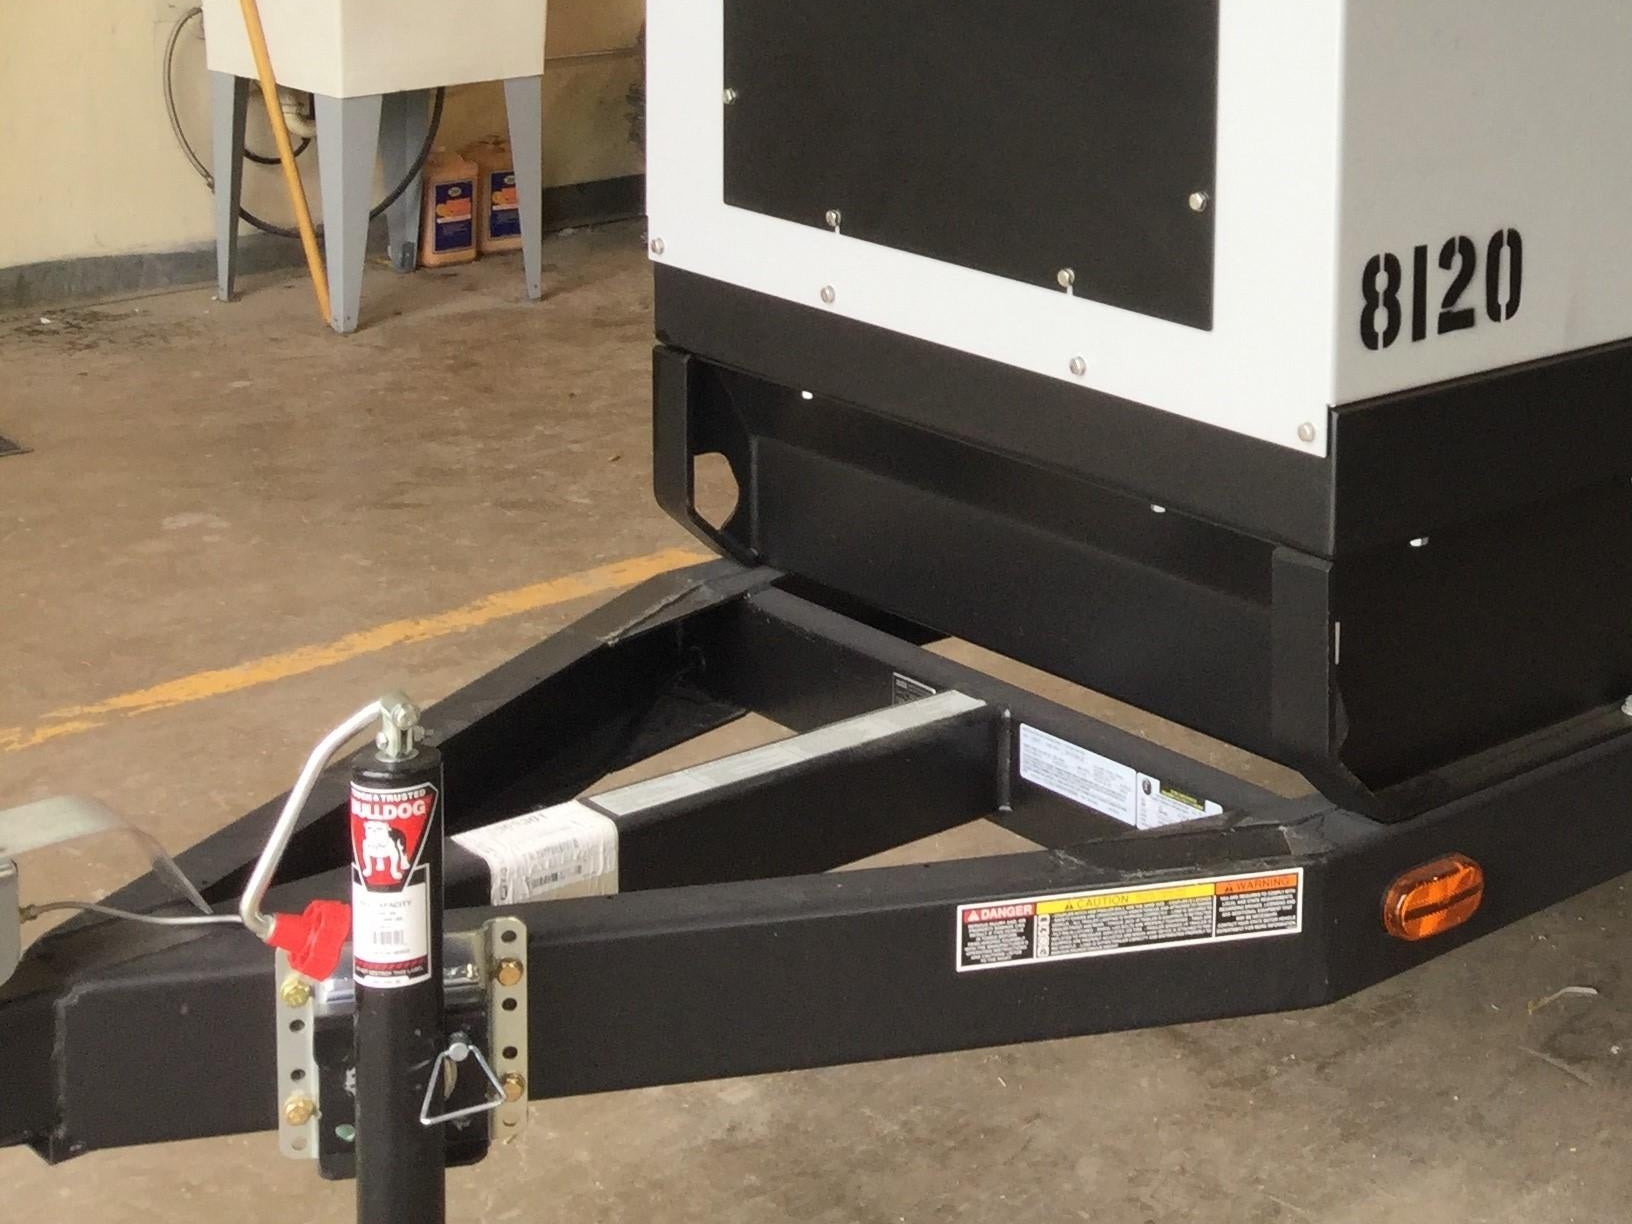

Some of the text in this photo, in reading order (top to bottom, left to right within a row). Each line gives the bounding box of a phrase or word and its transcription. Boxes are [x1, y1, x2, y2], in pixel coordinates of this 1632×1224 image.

[1360, 227, 1523, 351] 8120
[1237, 877, 1290, 890] WARNING
[1077, 895, 1129, 908] CAUTION
[981, 904, 1033, 921] DANGER
